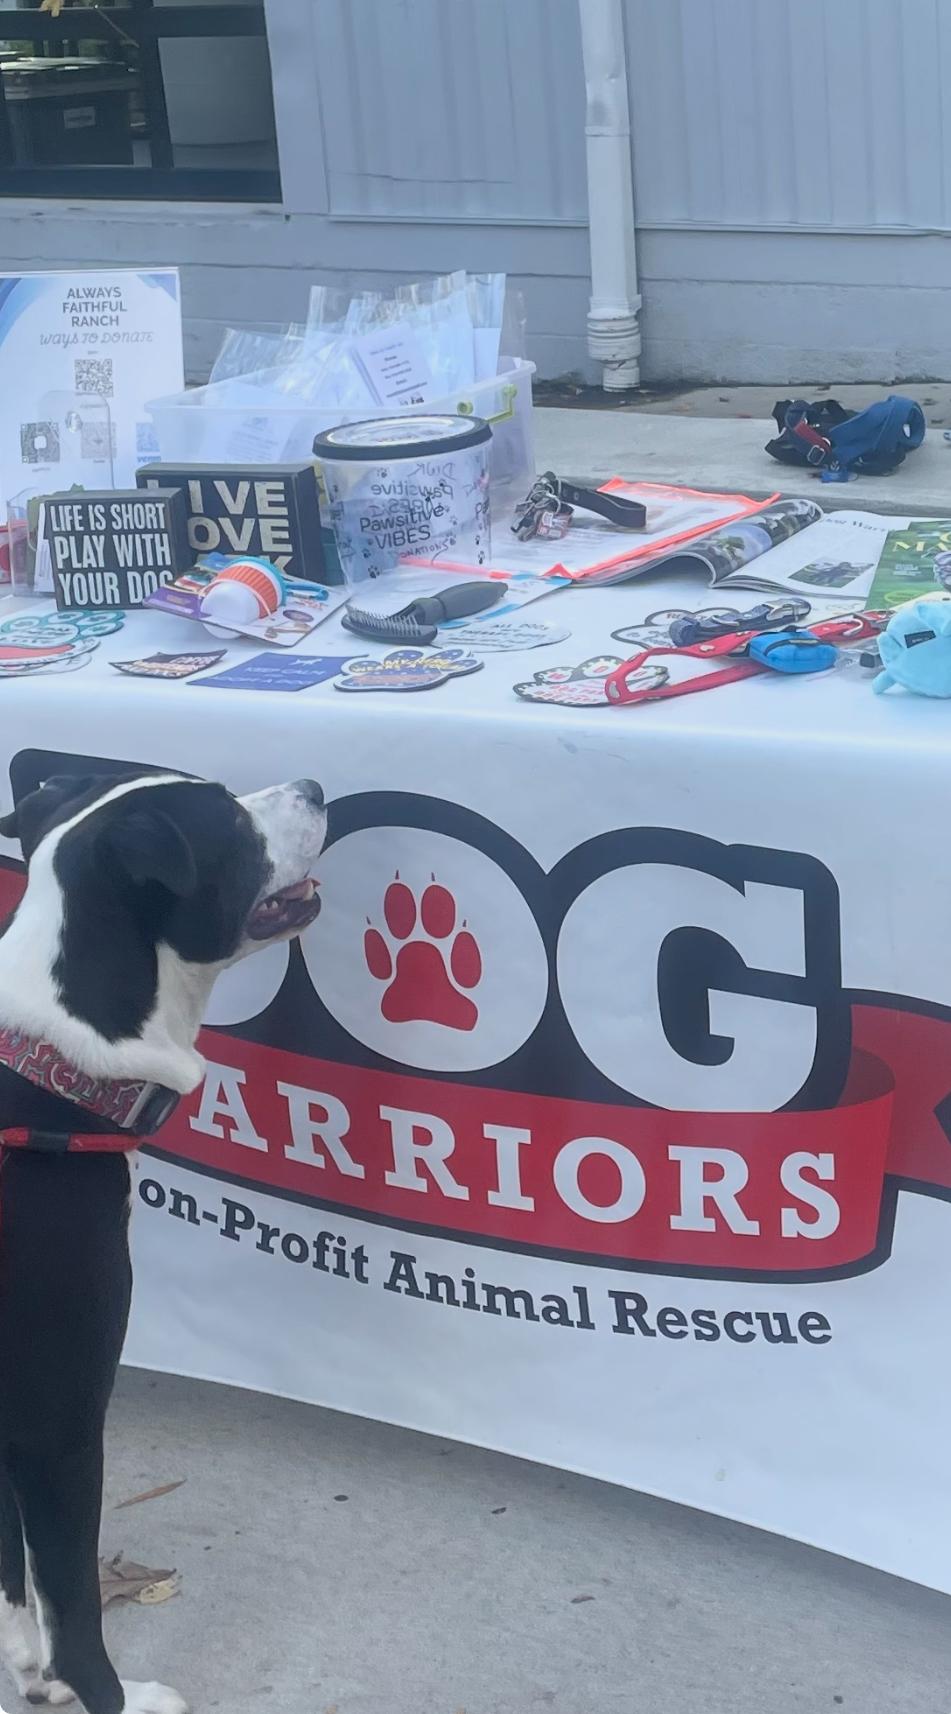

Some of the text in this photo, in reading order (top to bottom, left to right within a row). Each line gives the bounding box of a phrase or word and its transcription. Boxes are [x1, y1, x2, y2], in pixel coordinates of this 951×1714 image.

[62, 301, 127, 313] FAITHFUL
[67, 287, 121, 299] ALWAYS
[71, 316, 119, 327] RANCH
[147, 480, 288, 515] IVE
[50, 502, 165, 532] LIFE IS SHORT
[187, 516, 293, 552] OVE
[360, 503, 445, 533] Pawsitive
[54, 532, 172, 569] PLAY WITH
[374, 525, 431, 550] VIBES
[58, 571, 120, 606] YOUR
[203, 822, 818, 1112] OG
[189, 1063, 841, 1240] ARRIORS
[136, 1168, 832, 1345] on-Profit Animal Rescue
